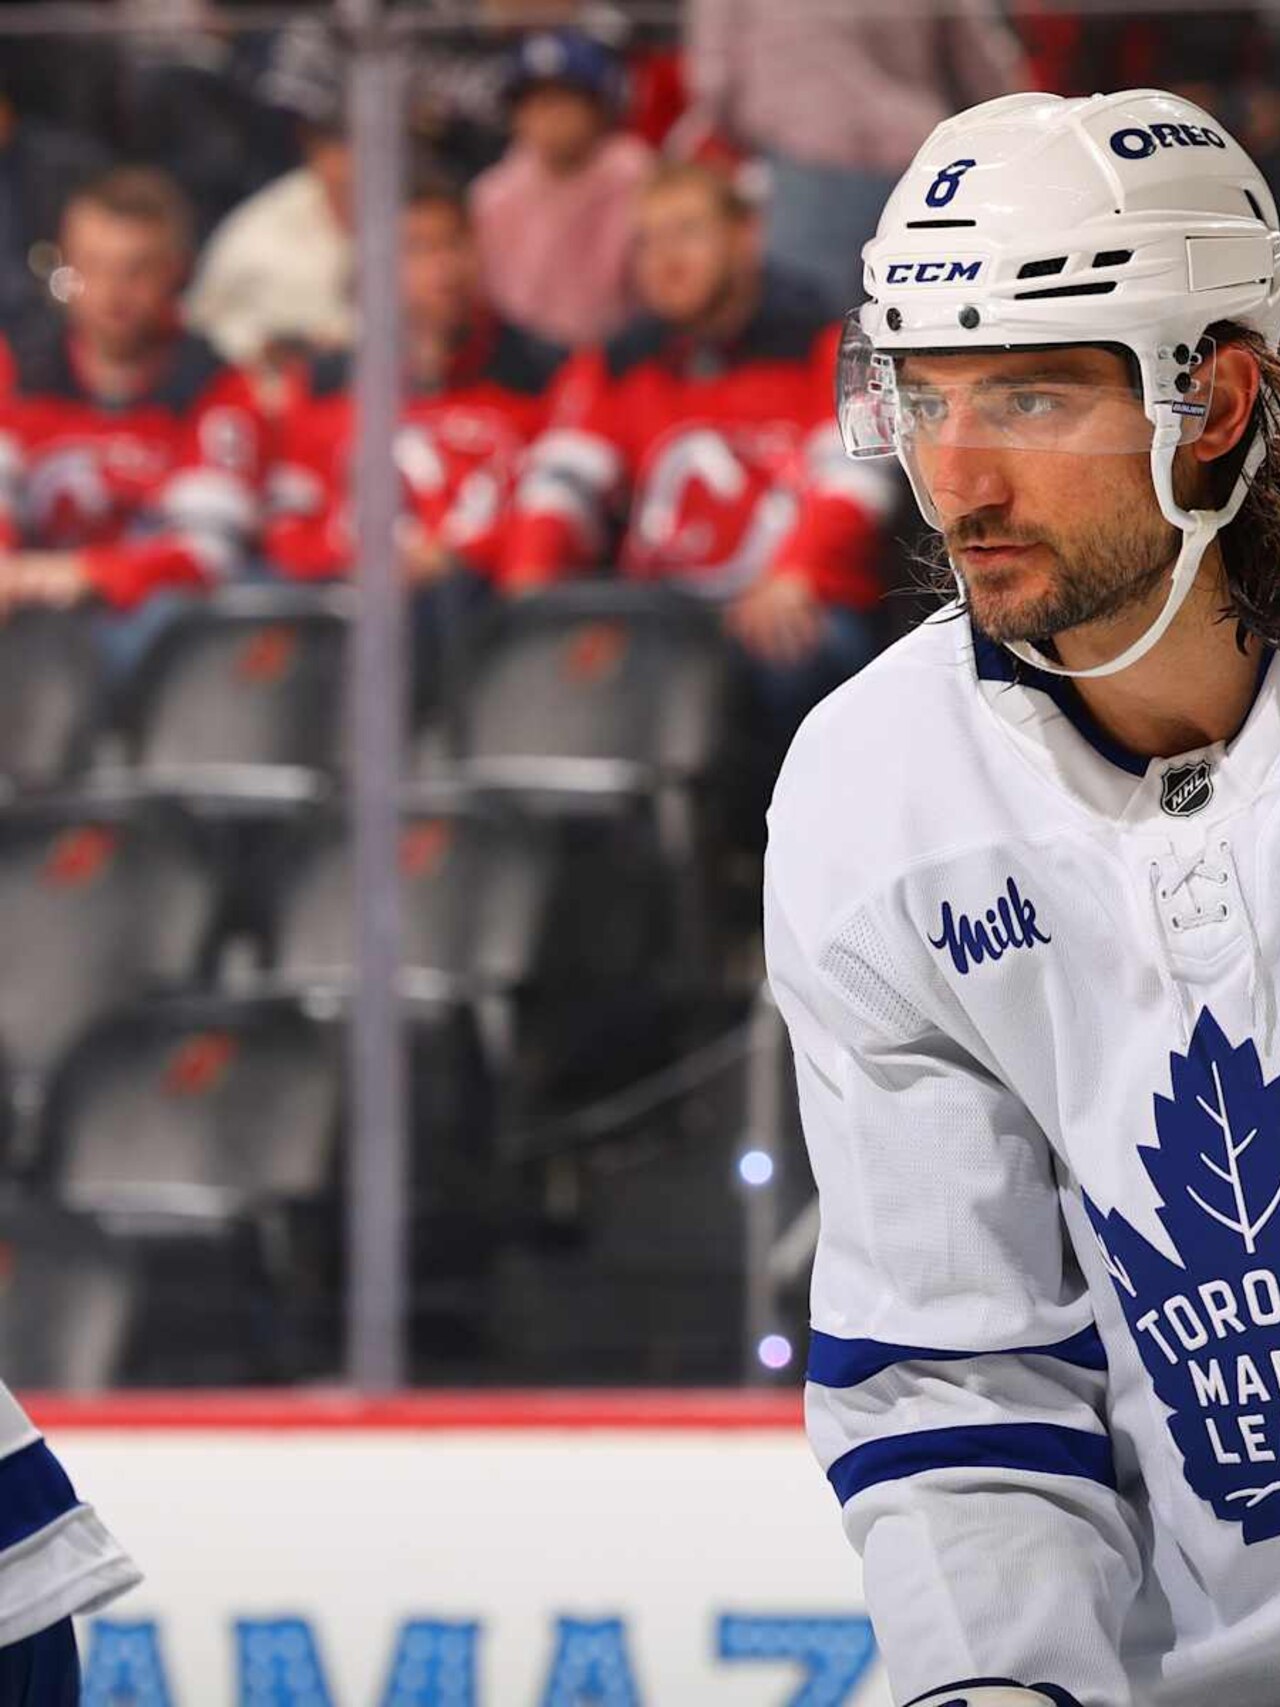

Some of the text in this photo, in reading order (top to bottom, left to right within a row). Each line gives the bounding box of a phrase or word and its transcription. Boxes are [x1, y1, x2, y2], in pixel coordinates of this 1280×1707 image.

[1109, 123, 1226, 160] OREO
[925, 158, 977, 208] 8
[886, 261, 983, 285] CCM
[1171, 773, 1204, 810] NHL
